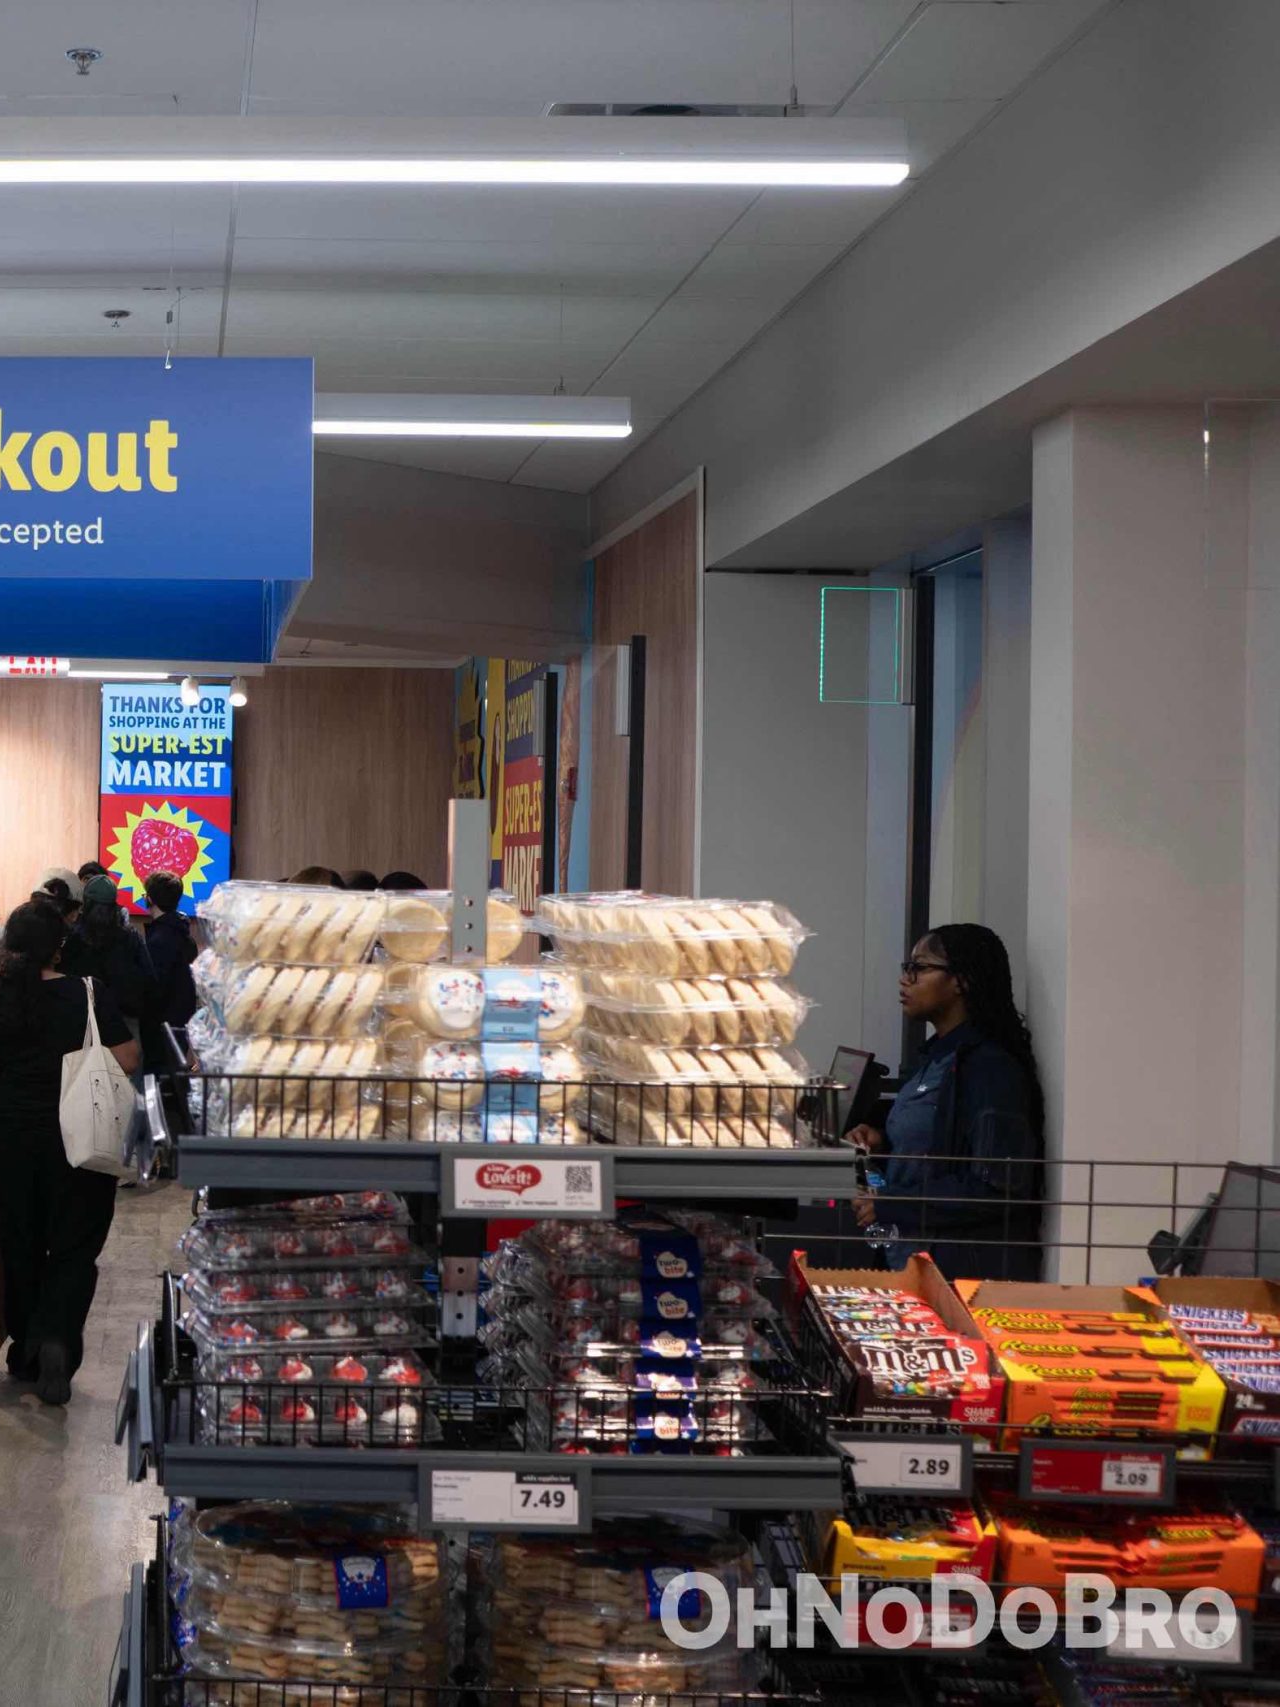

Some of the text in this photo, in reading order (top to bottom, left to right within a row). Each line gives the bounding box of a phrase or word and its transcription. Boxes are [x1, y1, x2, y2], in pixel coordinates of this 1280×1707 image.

[109, 696, 184, 714] THANKS
[109, 716, 226, 729] SHOPPING AT THE
[108, 734, 226, 755] SUPER-EST
[107, 760, 226, 788] MARKET
[1171, 1305, 1245, 1321] SNICKERS
[1235, 1395, 1253, 1409] 24
[964, 1407, 996, 1417] SHARE
[908, 1459, 950, 1475] 2.89
[1114, 1474, 1148, 1486] 2.09
[520, 1490, 566, 1508] 7.49
